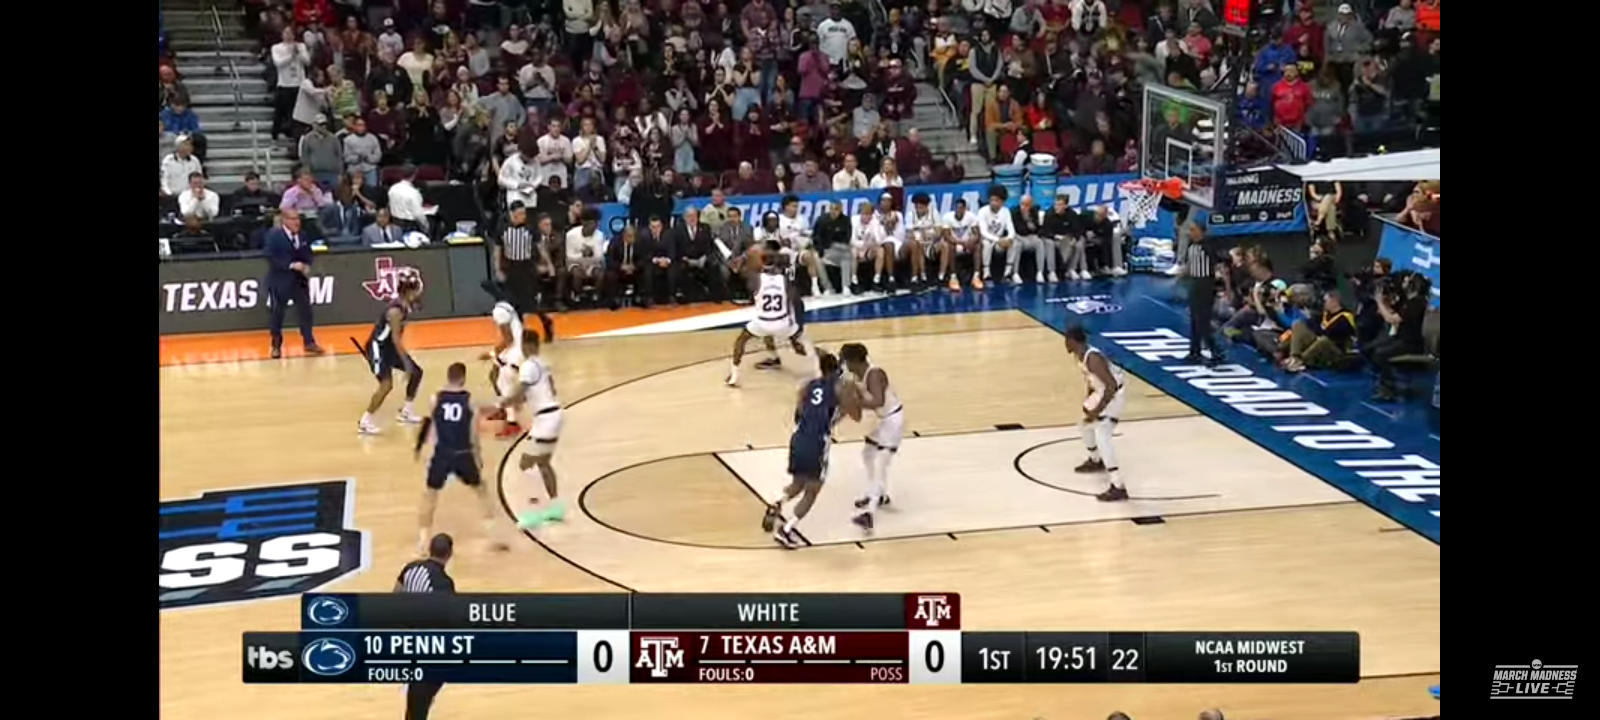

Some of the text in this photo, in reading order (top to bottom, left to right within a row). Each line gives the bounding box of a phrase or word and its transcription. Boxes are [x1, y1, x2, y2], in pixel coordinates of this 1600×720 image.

[1237, 187, 1302, 205] MADNESS
[163, 279, 258, 312] TEXAS
[762, 294, 783, 312] 23
[810, 387, 824, 406] 3
[441, 402, 463, 422] 10
[1100, 327, 1440, 503] THE ROAD TO THE
